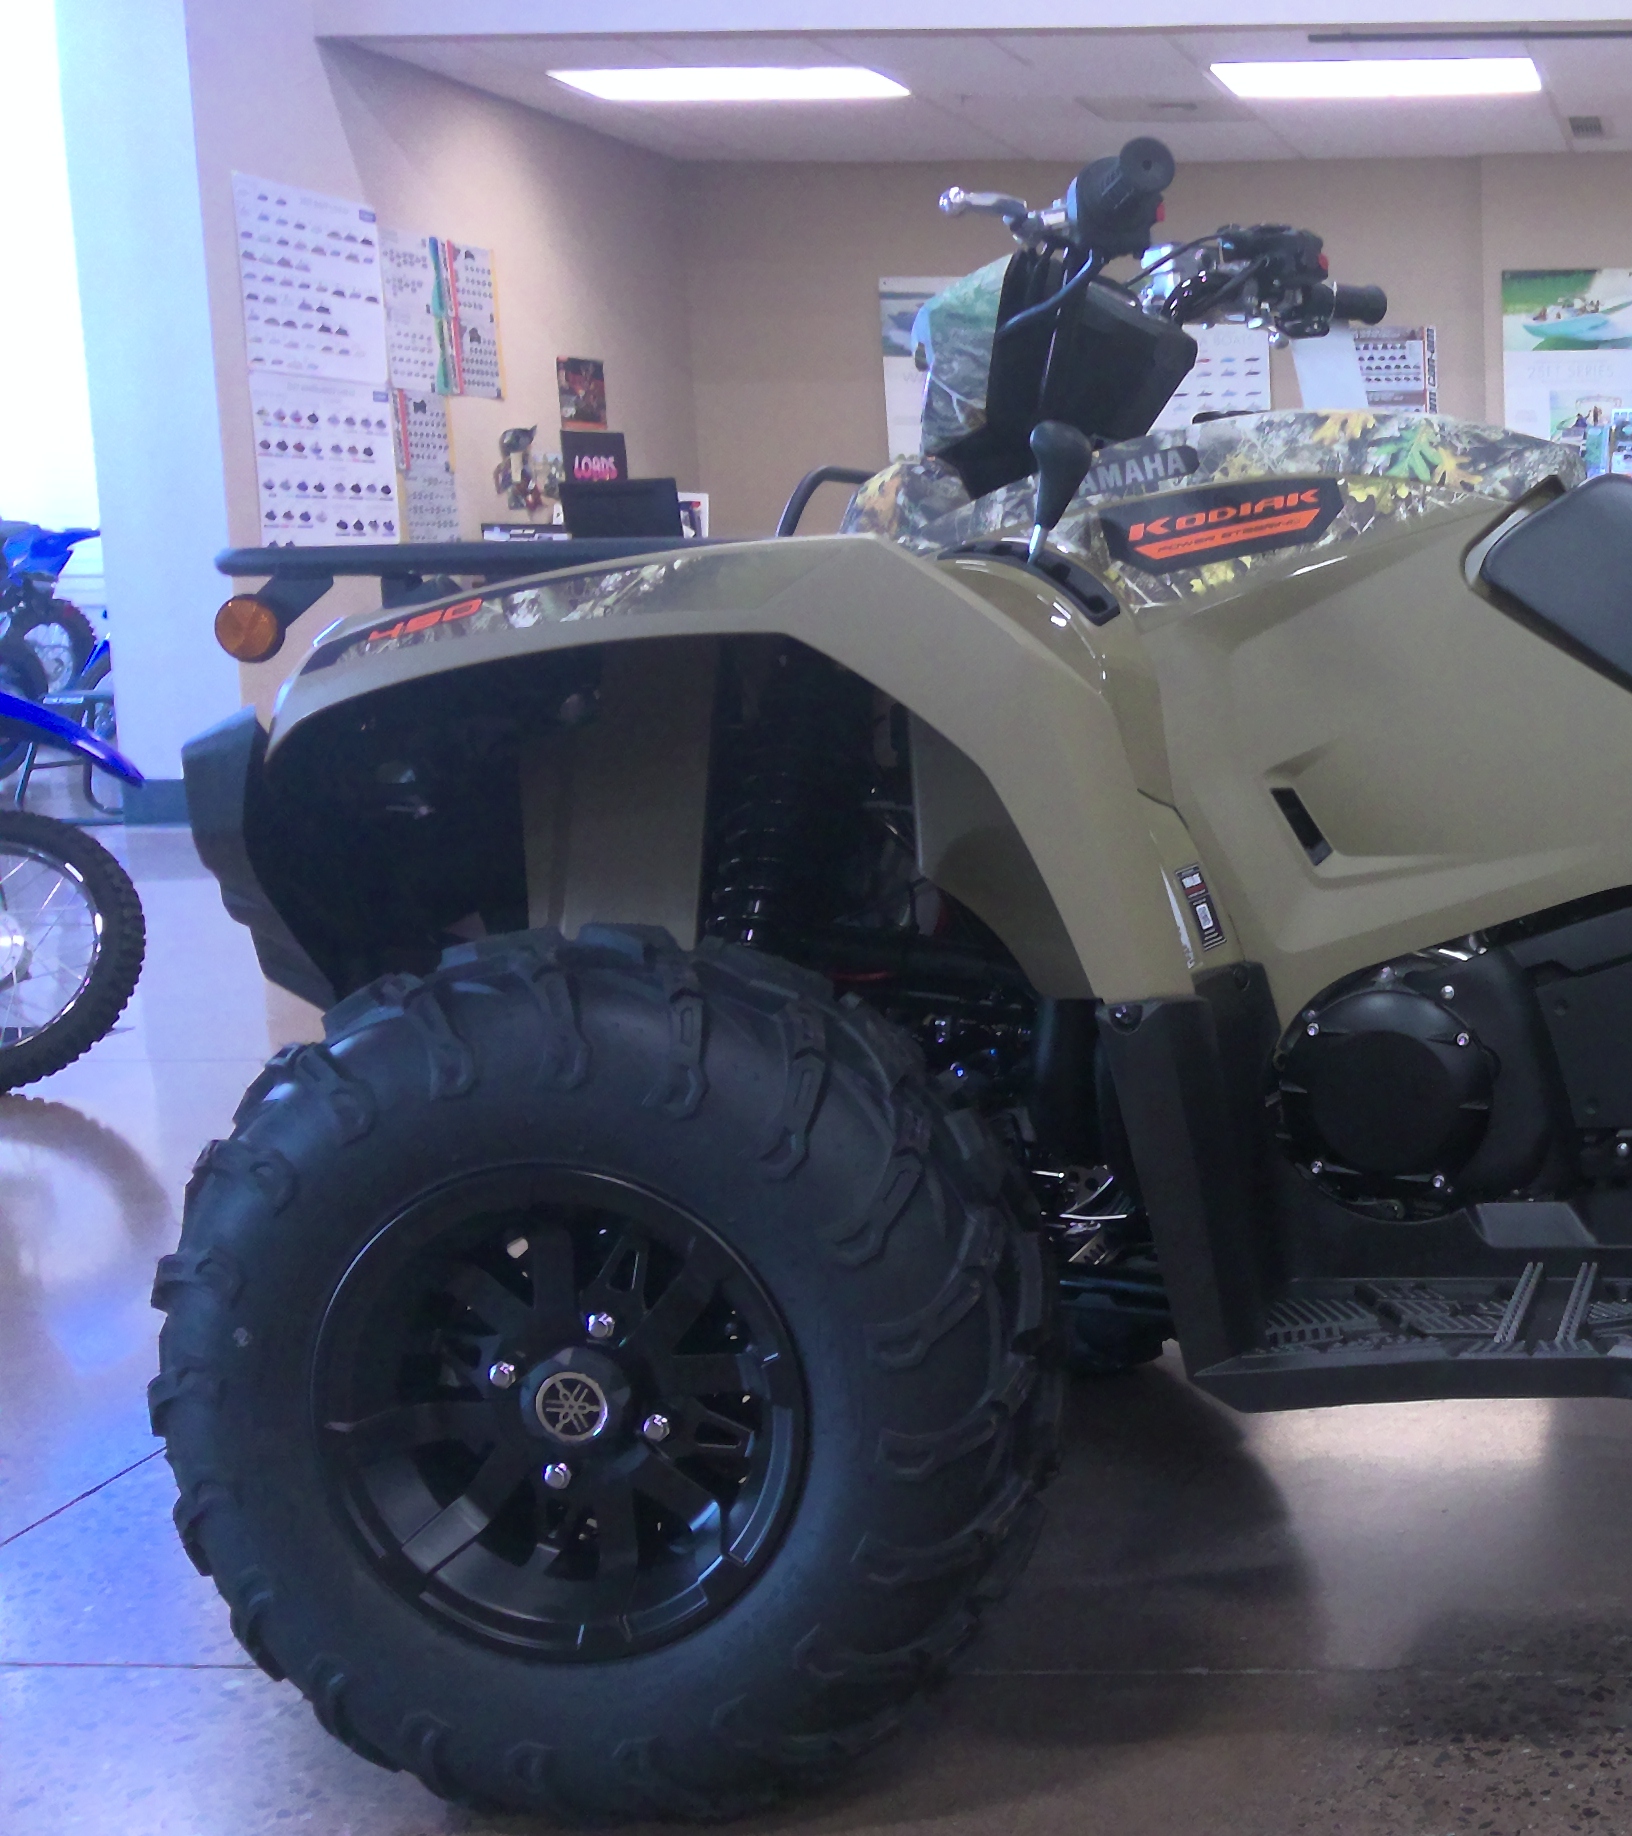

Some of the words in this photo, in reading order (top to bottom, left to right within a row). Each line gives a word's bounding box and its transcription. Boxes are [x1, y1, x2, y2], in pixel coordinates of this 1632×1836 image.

[1568, 364, 1614, 379] SERIES
[1078, 449, 1187, 497] AMAHA
[1127, 487, 1320, 542] KODIAK
[1156, 535, 1216, 553] POWER
[1220, 517, 1301, 540] STEERING
